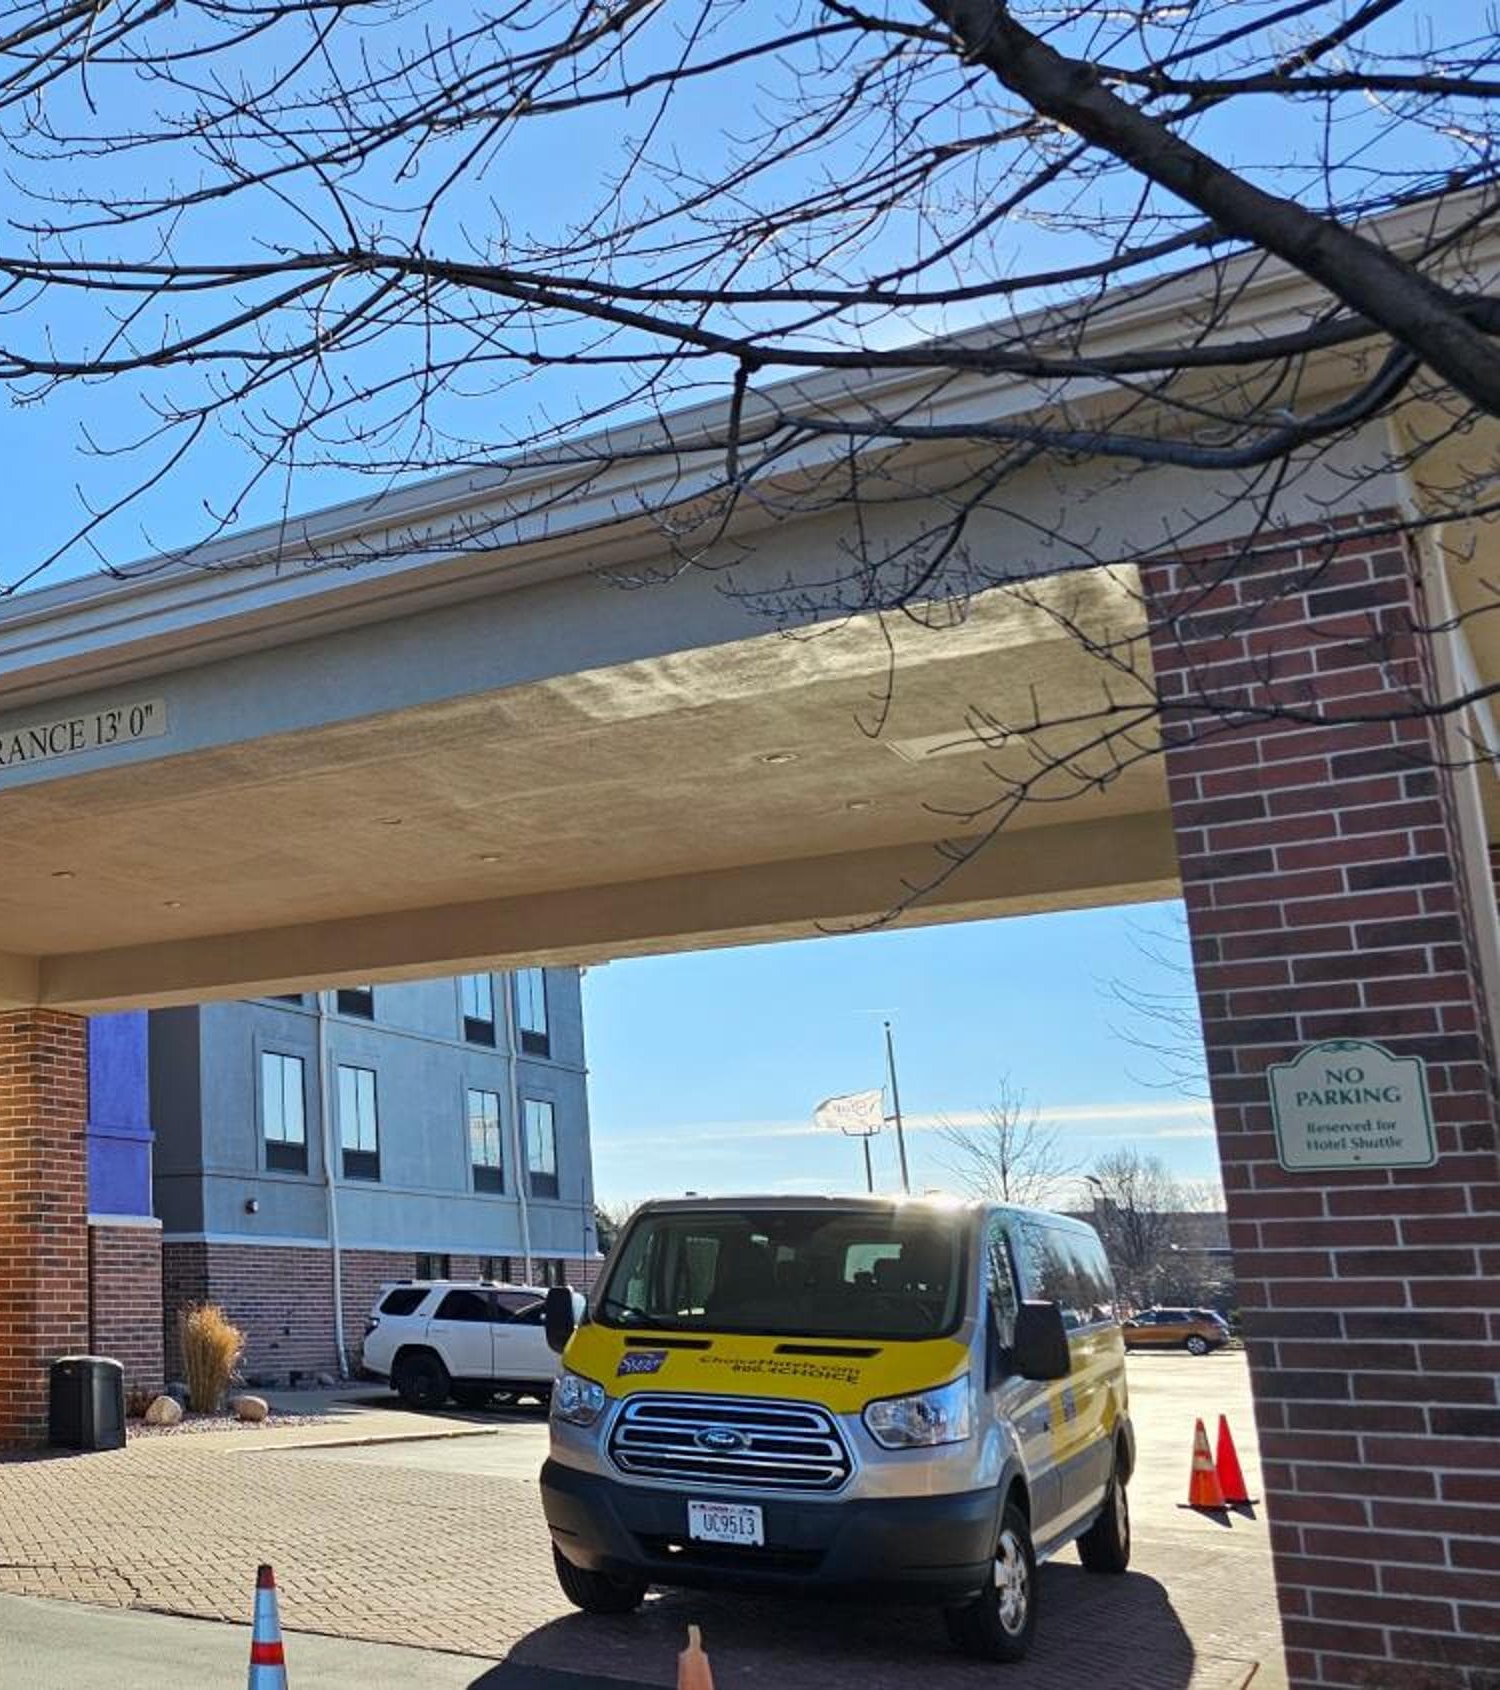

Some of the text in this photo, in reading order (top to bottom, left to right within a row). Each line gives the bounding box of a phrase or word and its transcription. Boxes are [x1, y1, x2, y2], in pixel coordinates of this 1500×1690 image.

[94, 711, 123, 745] 13'
[129, 703, 154, 737] 0"
[1325, 1067, 1365, 1085] NO
[1296, 1086, 1402, 1107] PARKING
[1307, 1119, 1397, 1134] Reserved for
[1306, 1135, 1403, 1151] Hotel Shuttle
[703, 1512, 756, 1535] UC9513
